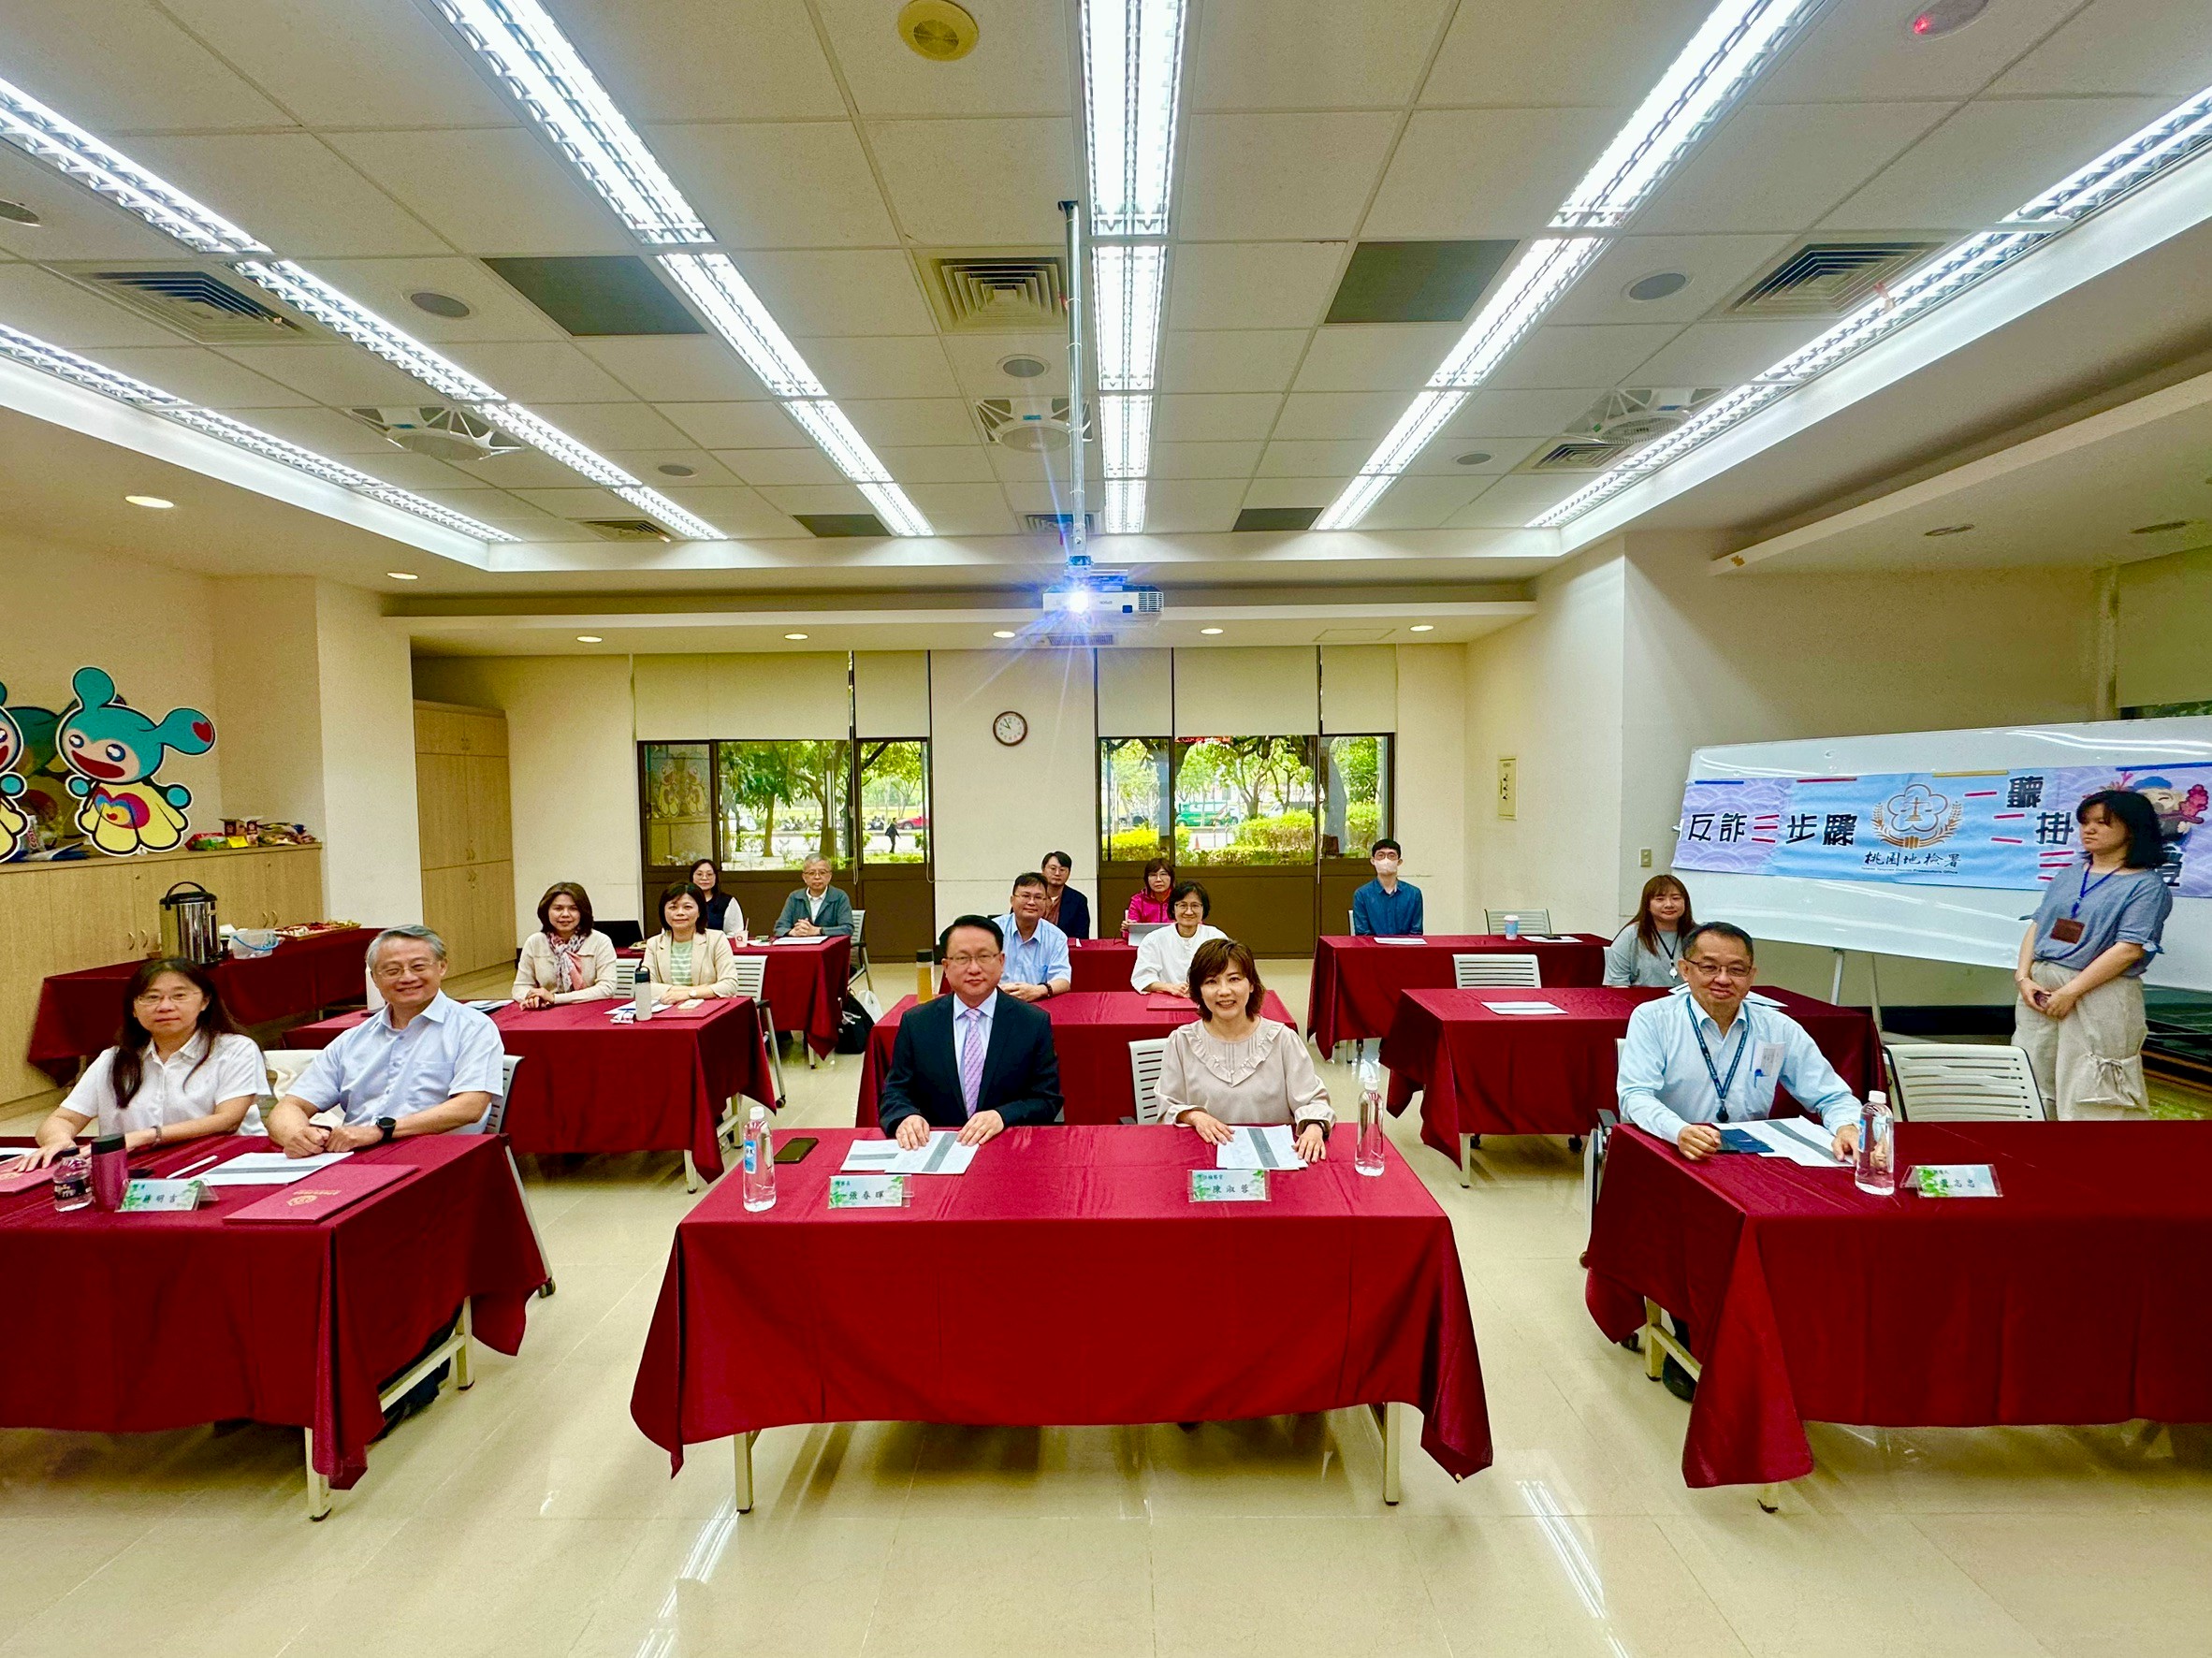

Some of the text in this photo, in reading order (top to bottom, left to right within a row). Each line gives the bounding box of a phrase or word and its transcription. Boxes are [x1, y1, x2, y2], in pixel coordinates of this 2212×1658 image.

[1687, 812, 1858, 847] 反詐三步驟
[1864, 851, 1961, 868] 桃園地檢署
